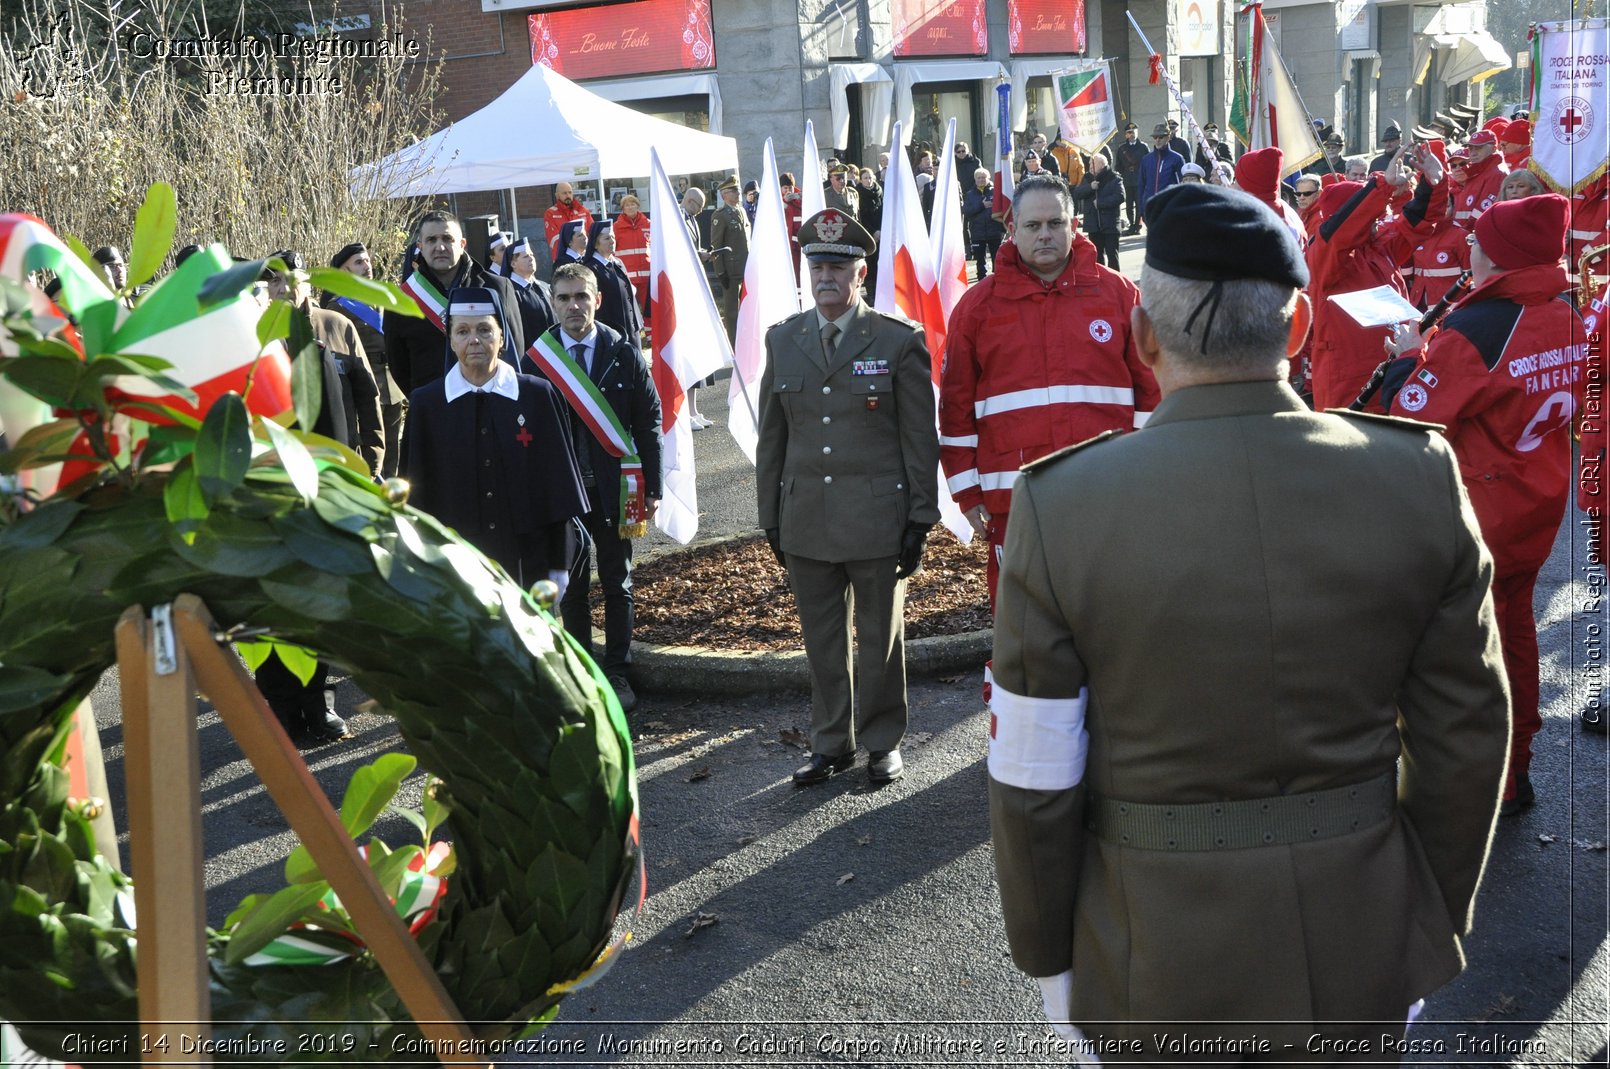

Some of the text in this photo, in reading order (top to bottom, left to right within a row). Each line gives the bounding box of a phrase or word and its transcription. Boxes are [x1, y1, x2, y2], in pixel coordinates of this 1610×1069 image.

[1555, 69, 1597, 80] ITALIANA
[1508, 354, 1538, 378] CROCE
[1539, 348, 1564, 370] ROSSA
[1526, 365, 1582, 396] FANFAR
